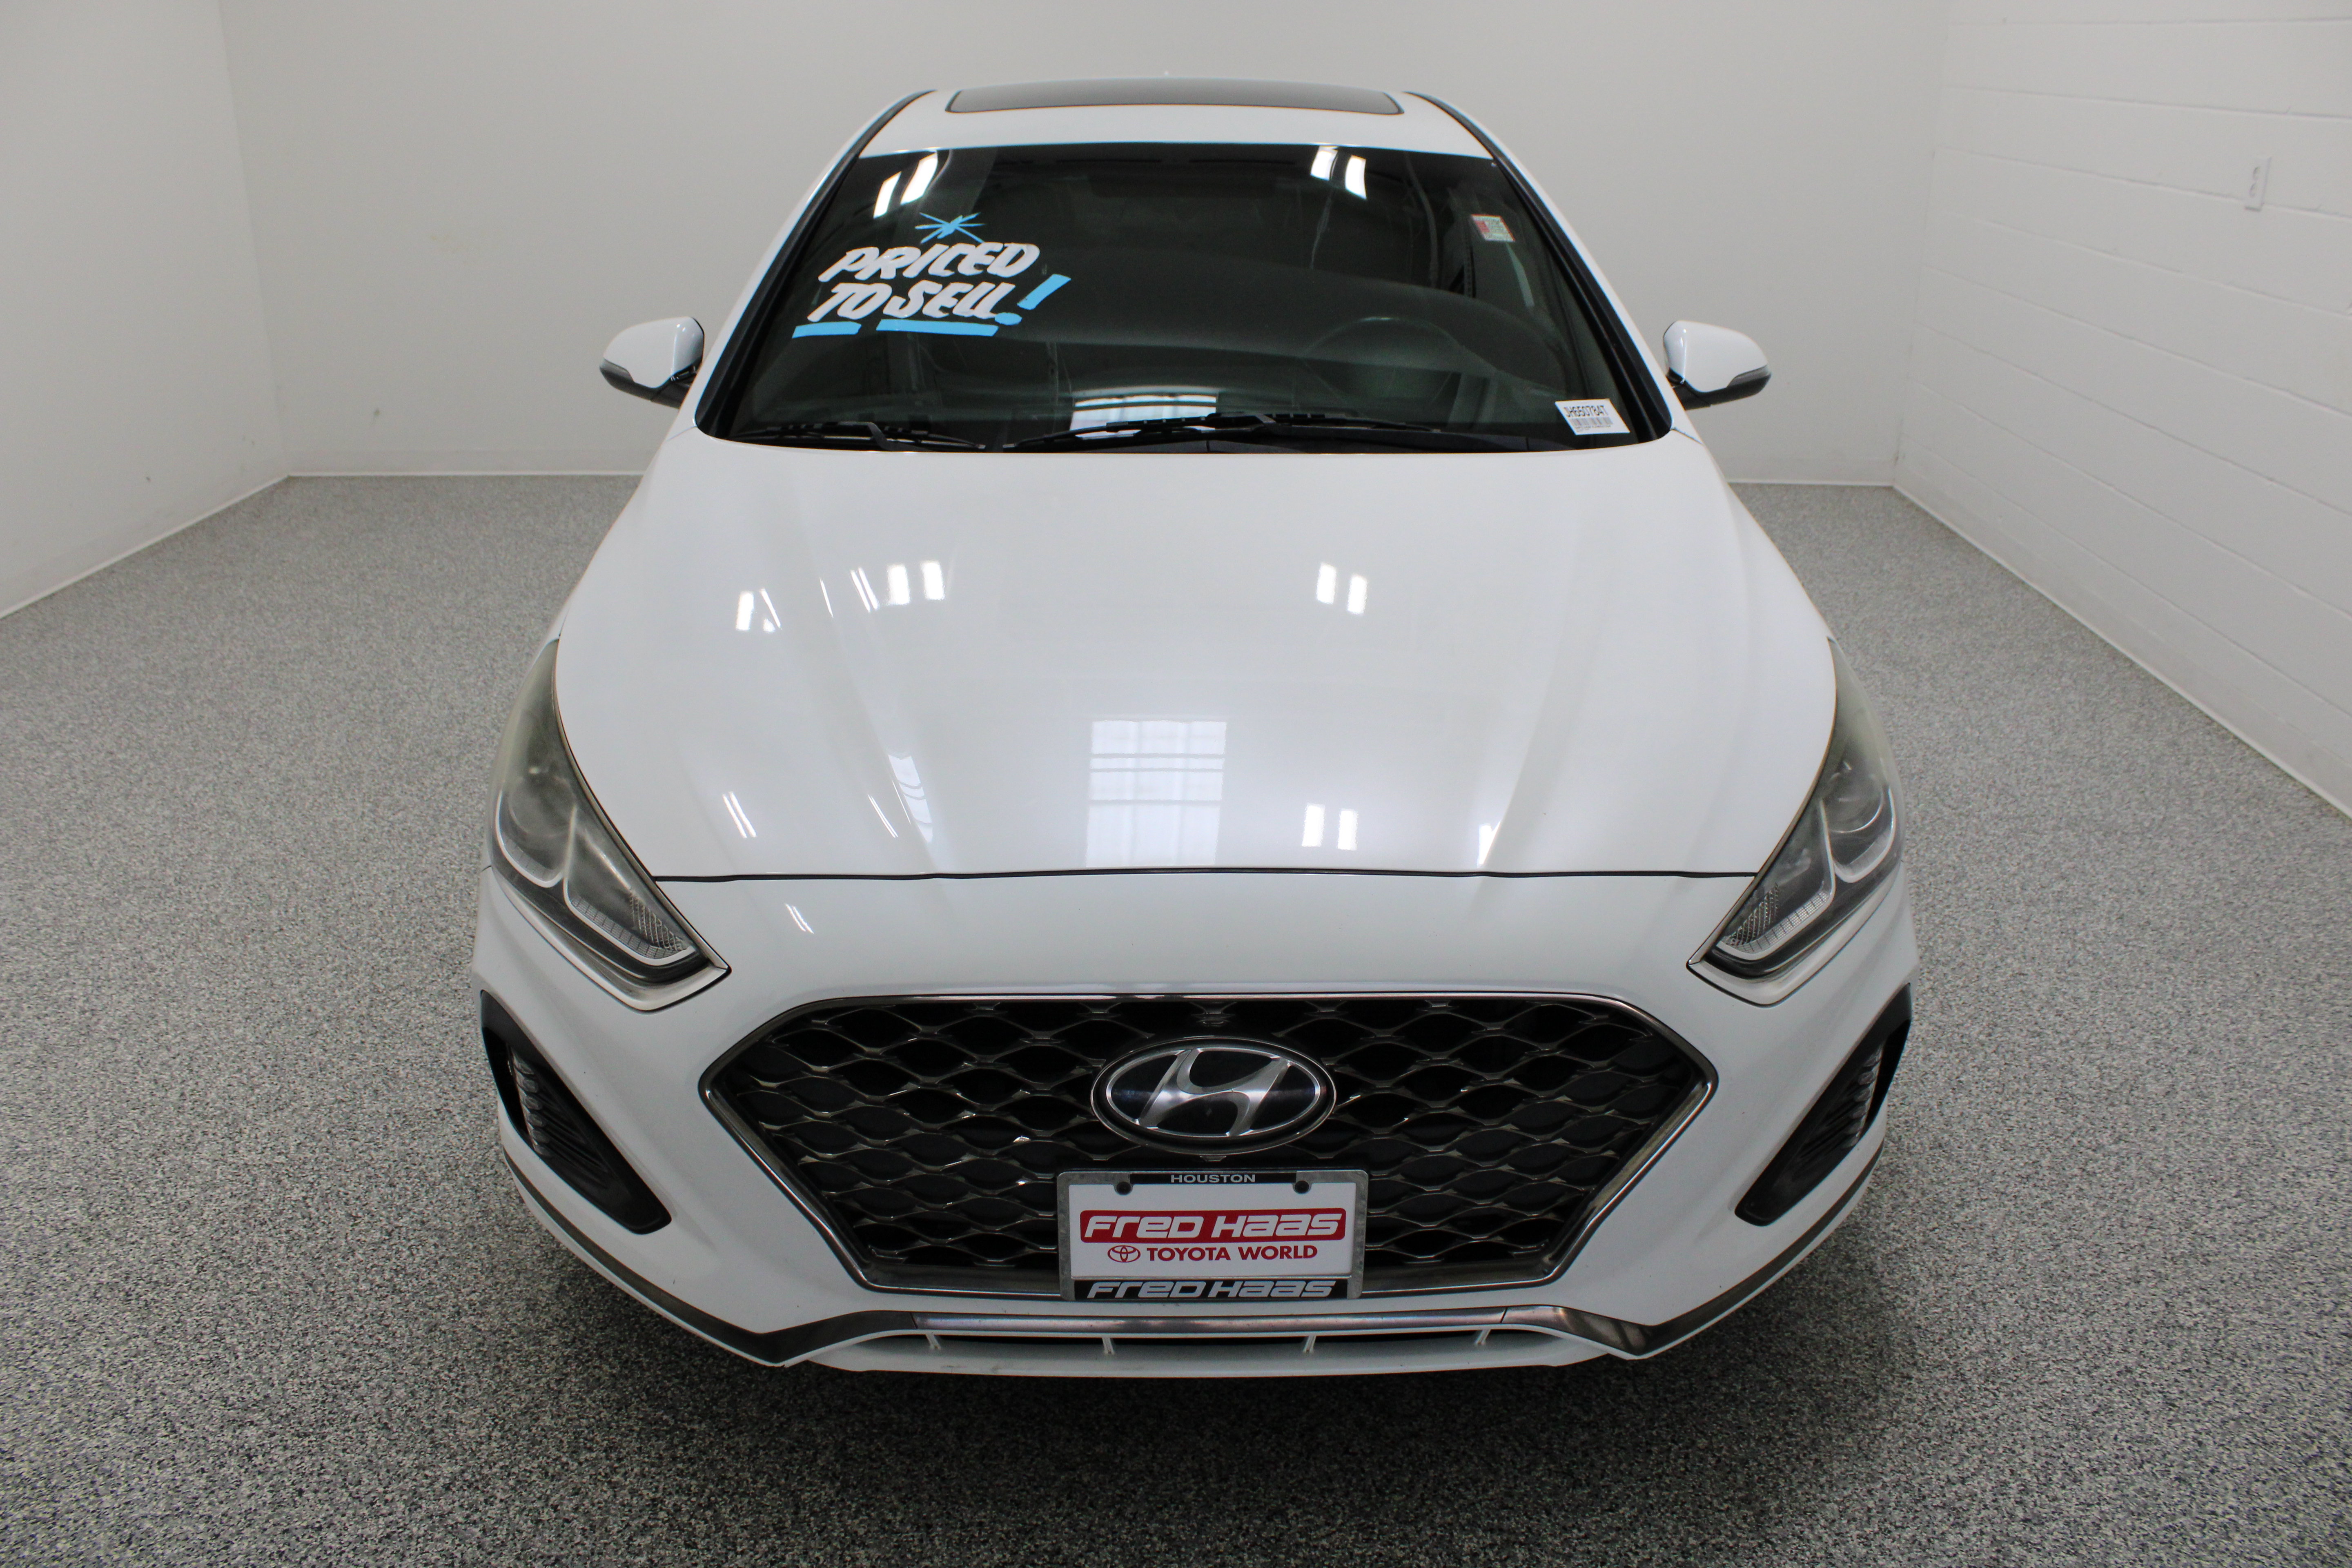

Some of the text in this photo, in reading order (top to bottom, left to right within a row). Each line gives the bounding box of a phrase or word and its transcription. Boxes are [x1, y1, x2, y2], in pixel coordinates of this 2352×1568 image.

[818, 242, 1040, 282] PRICED
[807, 282, 892, 322] TO
[1171, 1174, 1255, 1183] HOUSTON
[1147, 1245, 1318, 1261] TOYOTA WORLD
